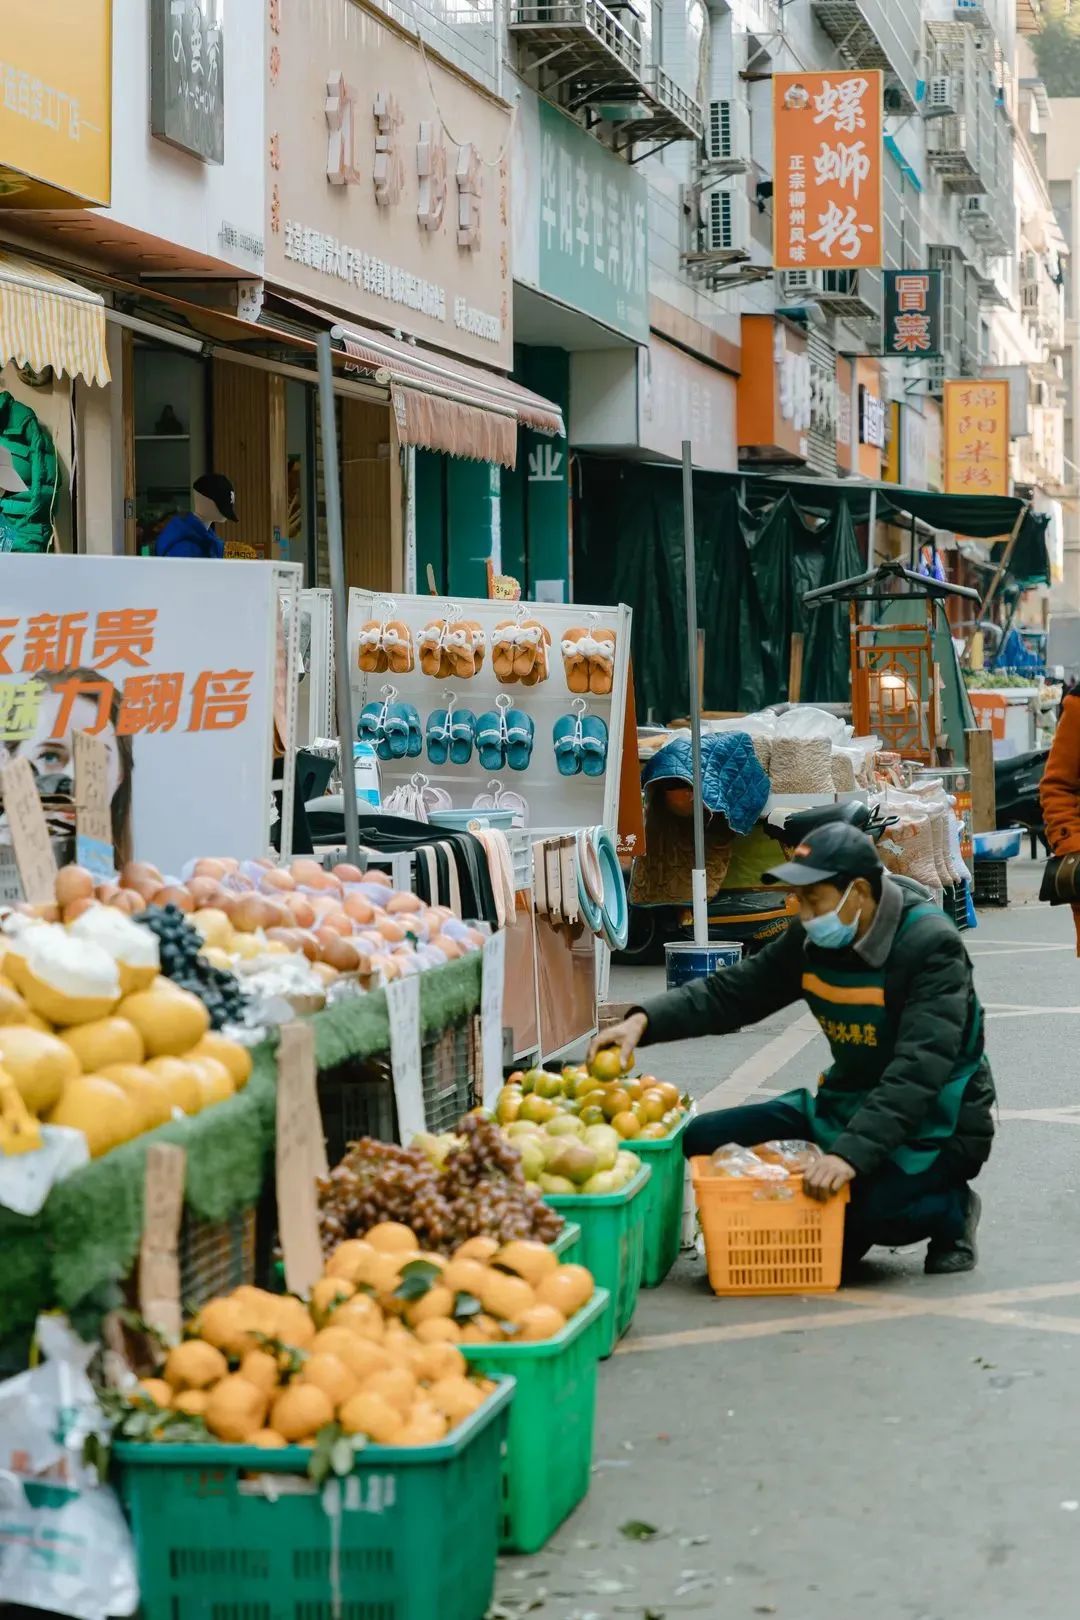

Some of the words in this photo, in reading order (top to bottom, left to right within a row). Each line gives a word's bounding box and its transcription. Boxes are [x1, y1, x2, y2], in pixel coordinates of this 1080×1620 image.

[788, 154, 807, 262] 正宗柳州风味
[808, 77, 874, 260] 螺蛳粉
[894, 275, 931, 351] 冒菜
